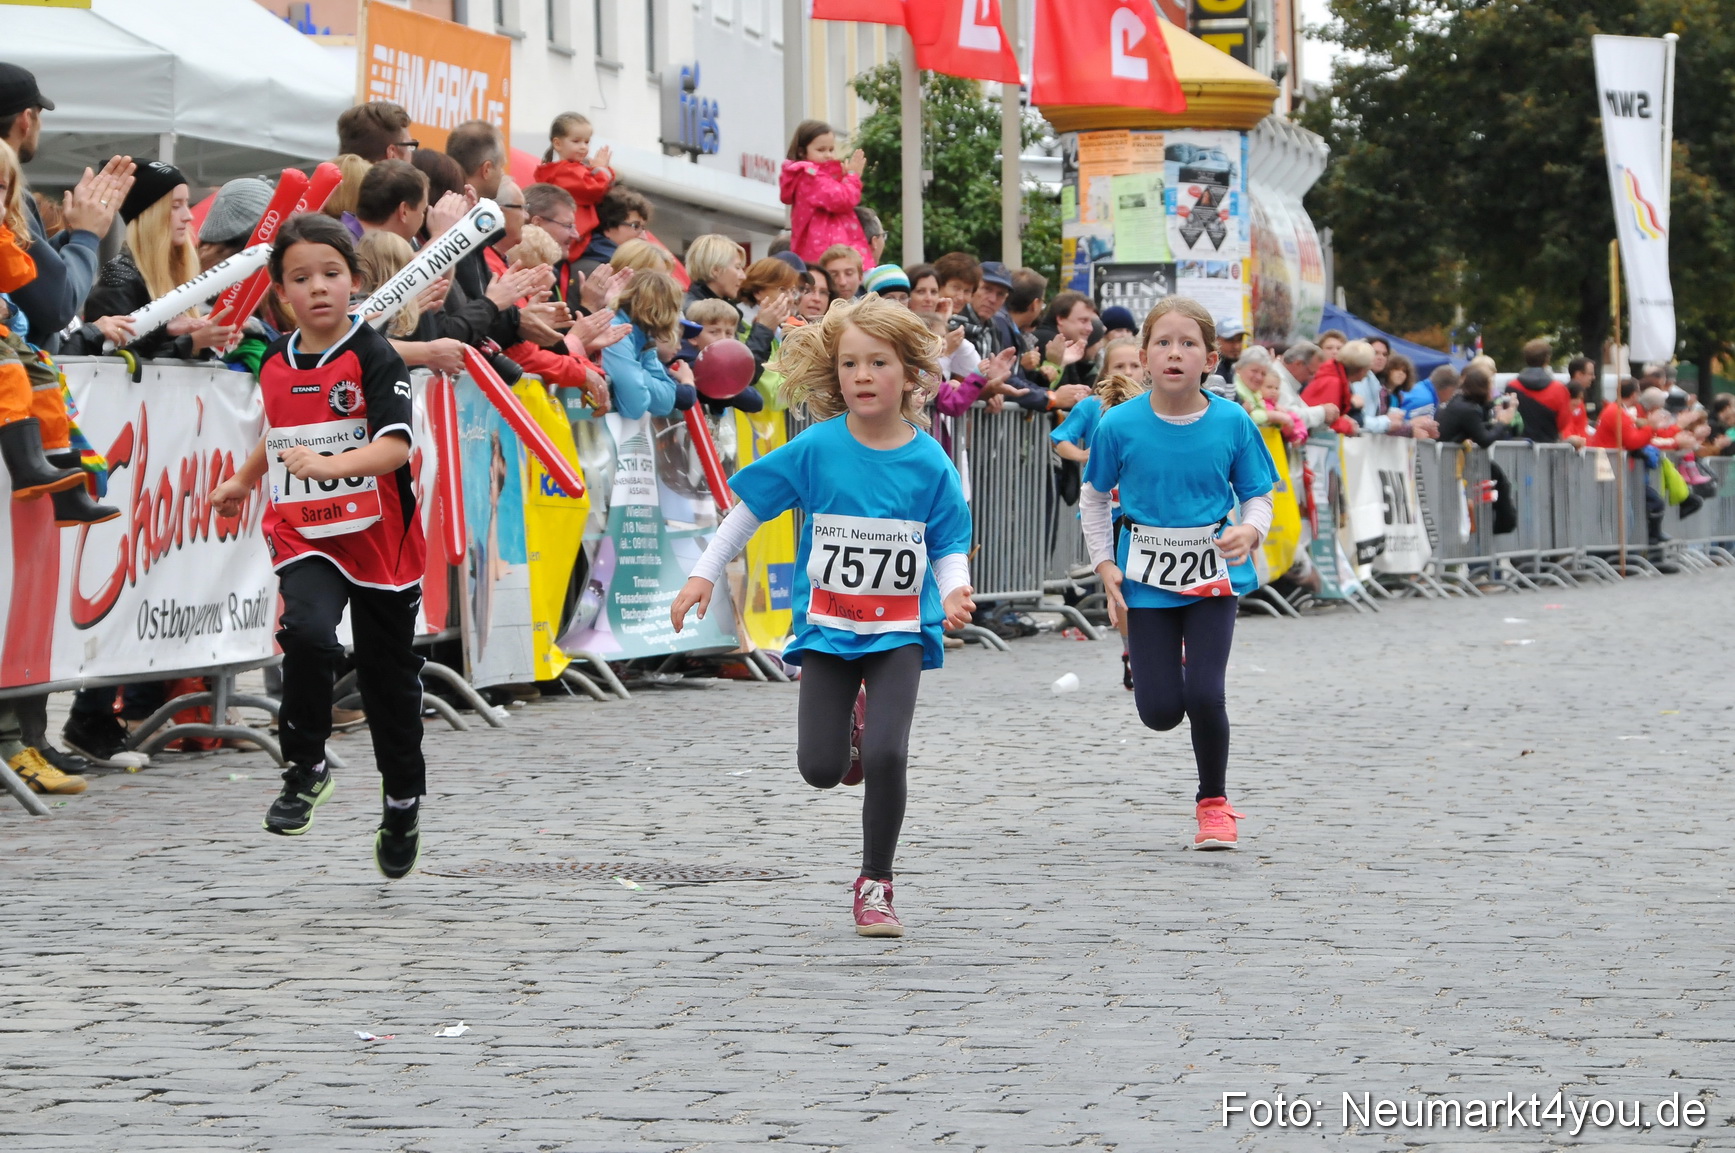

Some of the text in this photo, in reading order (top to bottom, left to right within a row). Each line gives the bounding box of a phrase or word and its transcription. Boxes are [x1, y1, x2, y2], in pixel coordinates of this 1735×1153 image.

[427, 231, 471, 275] BMW
[1100, 281, 1168, 297] GLENN
[267, 432, 349, 450] PARTL Neumarkt
[301, 503, 343, 523] Sarah
[815, 526, 908, 542] PARTL Neumarkt
[1132, 534, 1211, 547] PARTL Neumarkt
[822, 544, 917, 590] 7579
[1140, 548, 1218, 586] 7220
[137, 587, 269, 644] Ostbayerns Radio
[826, 592, 864, 620] Marie
